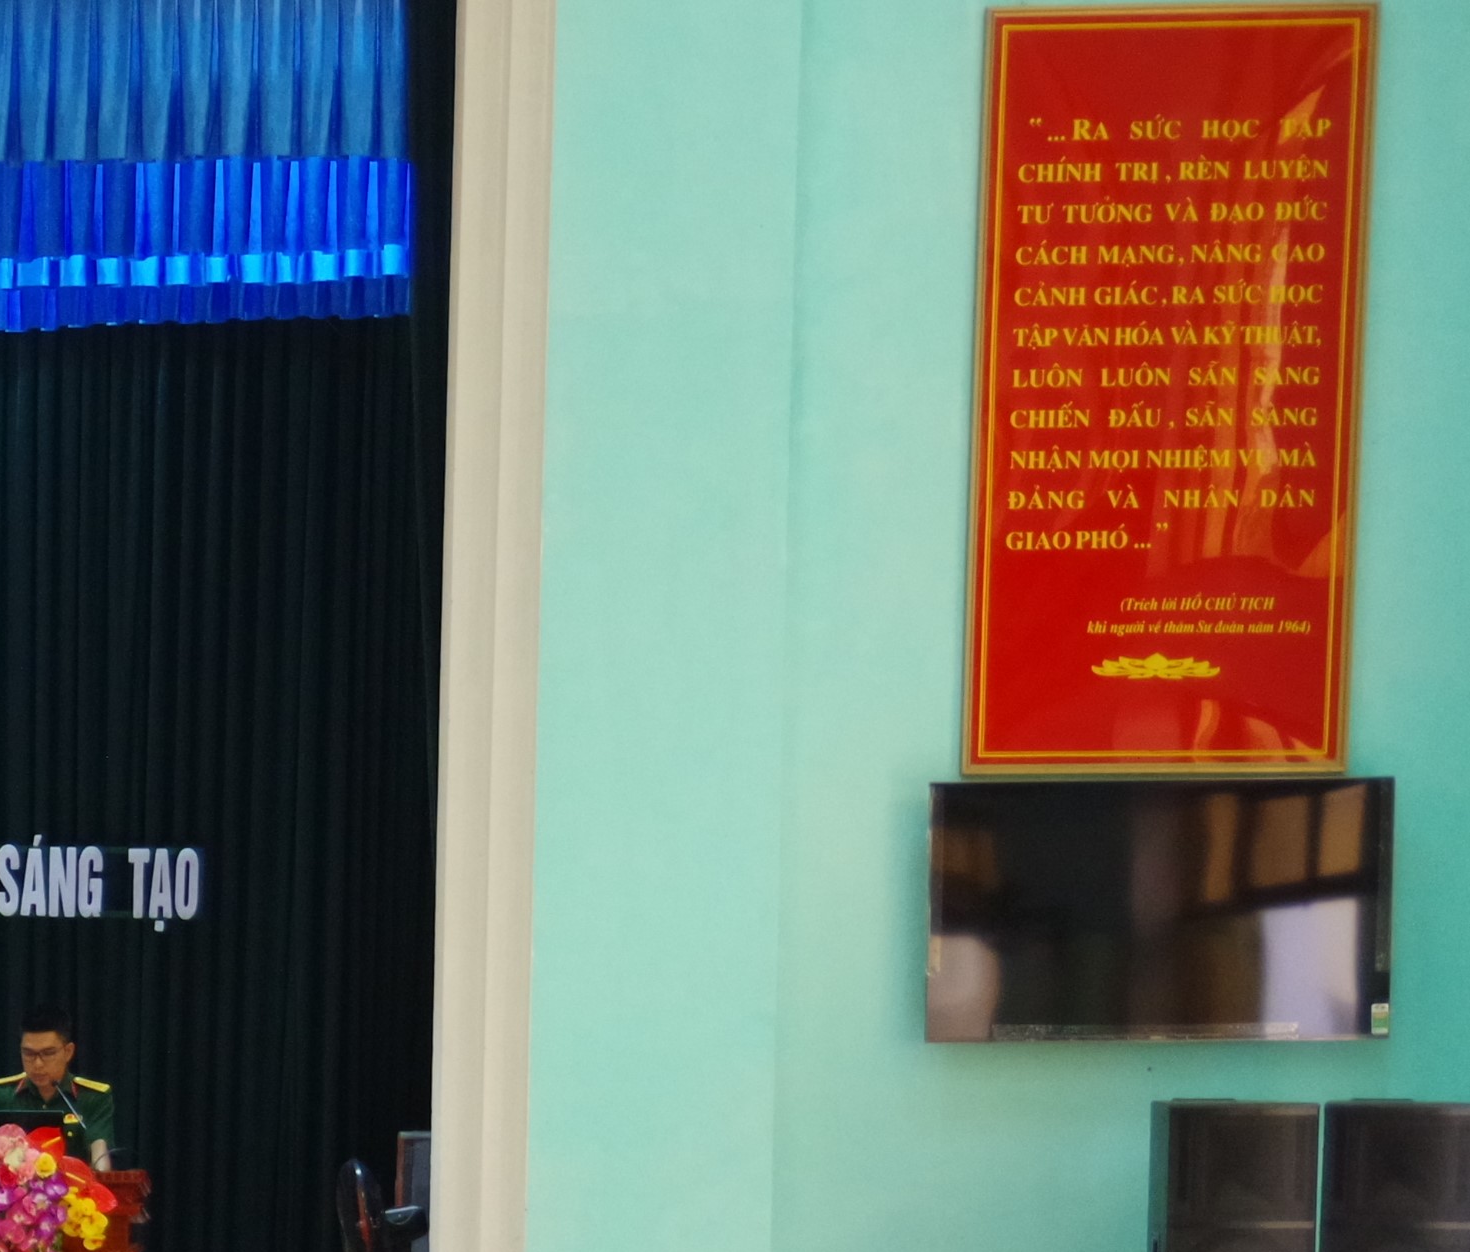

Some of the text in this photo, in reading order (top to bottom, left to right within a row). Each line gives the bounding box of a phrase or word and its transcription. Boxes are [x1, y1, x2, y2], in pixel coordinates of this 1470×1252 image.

[1129, 114, 1181, 140] SỨC
[1202, 119, 1260, 142] HỌC
[1018, 157, 1102, 183] CHÍNH
[1179, 155, 1230, 181] RÈN
[1244, 154, 1328, 181] LUYỆN
[1017, 195, 1328, 225] TƯ TƯỞNG VÀ ĐẠO ĐỨC
[1015, 240, 1325, 268] CÁCH MẠNG, NÂNG CAO
[1014, 281, 1086, 306] CẢNH
[1172, 285, 1205, 304] RA
[1213, 279, 1262, 304] SỨC
[1270, 284, 1323, 307] HỌC
[1013, 323, 1058, 349] TẬP
[1063, 325, 1109, 346] VĂN
[1115, 321, 1163, 346] HÓA
[1170, 321, 1199, 345] VÀ
[1203, 321, 1237, 345] KỸ
[1010, 401, 1090, 429] CHIẾN
[1186, 401, 1234, 427] SẴN
[1008, 485, 1315, 510] ĐẢNG VÀ NHÂN DÂN
[1006, 531, 1071, 550] GIAO
[127, 846, 199, 936] TẠO
